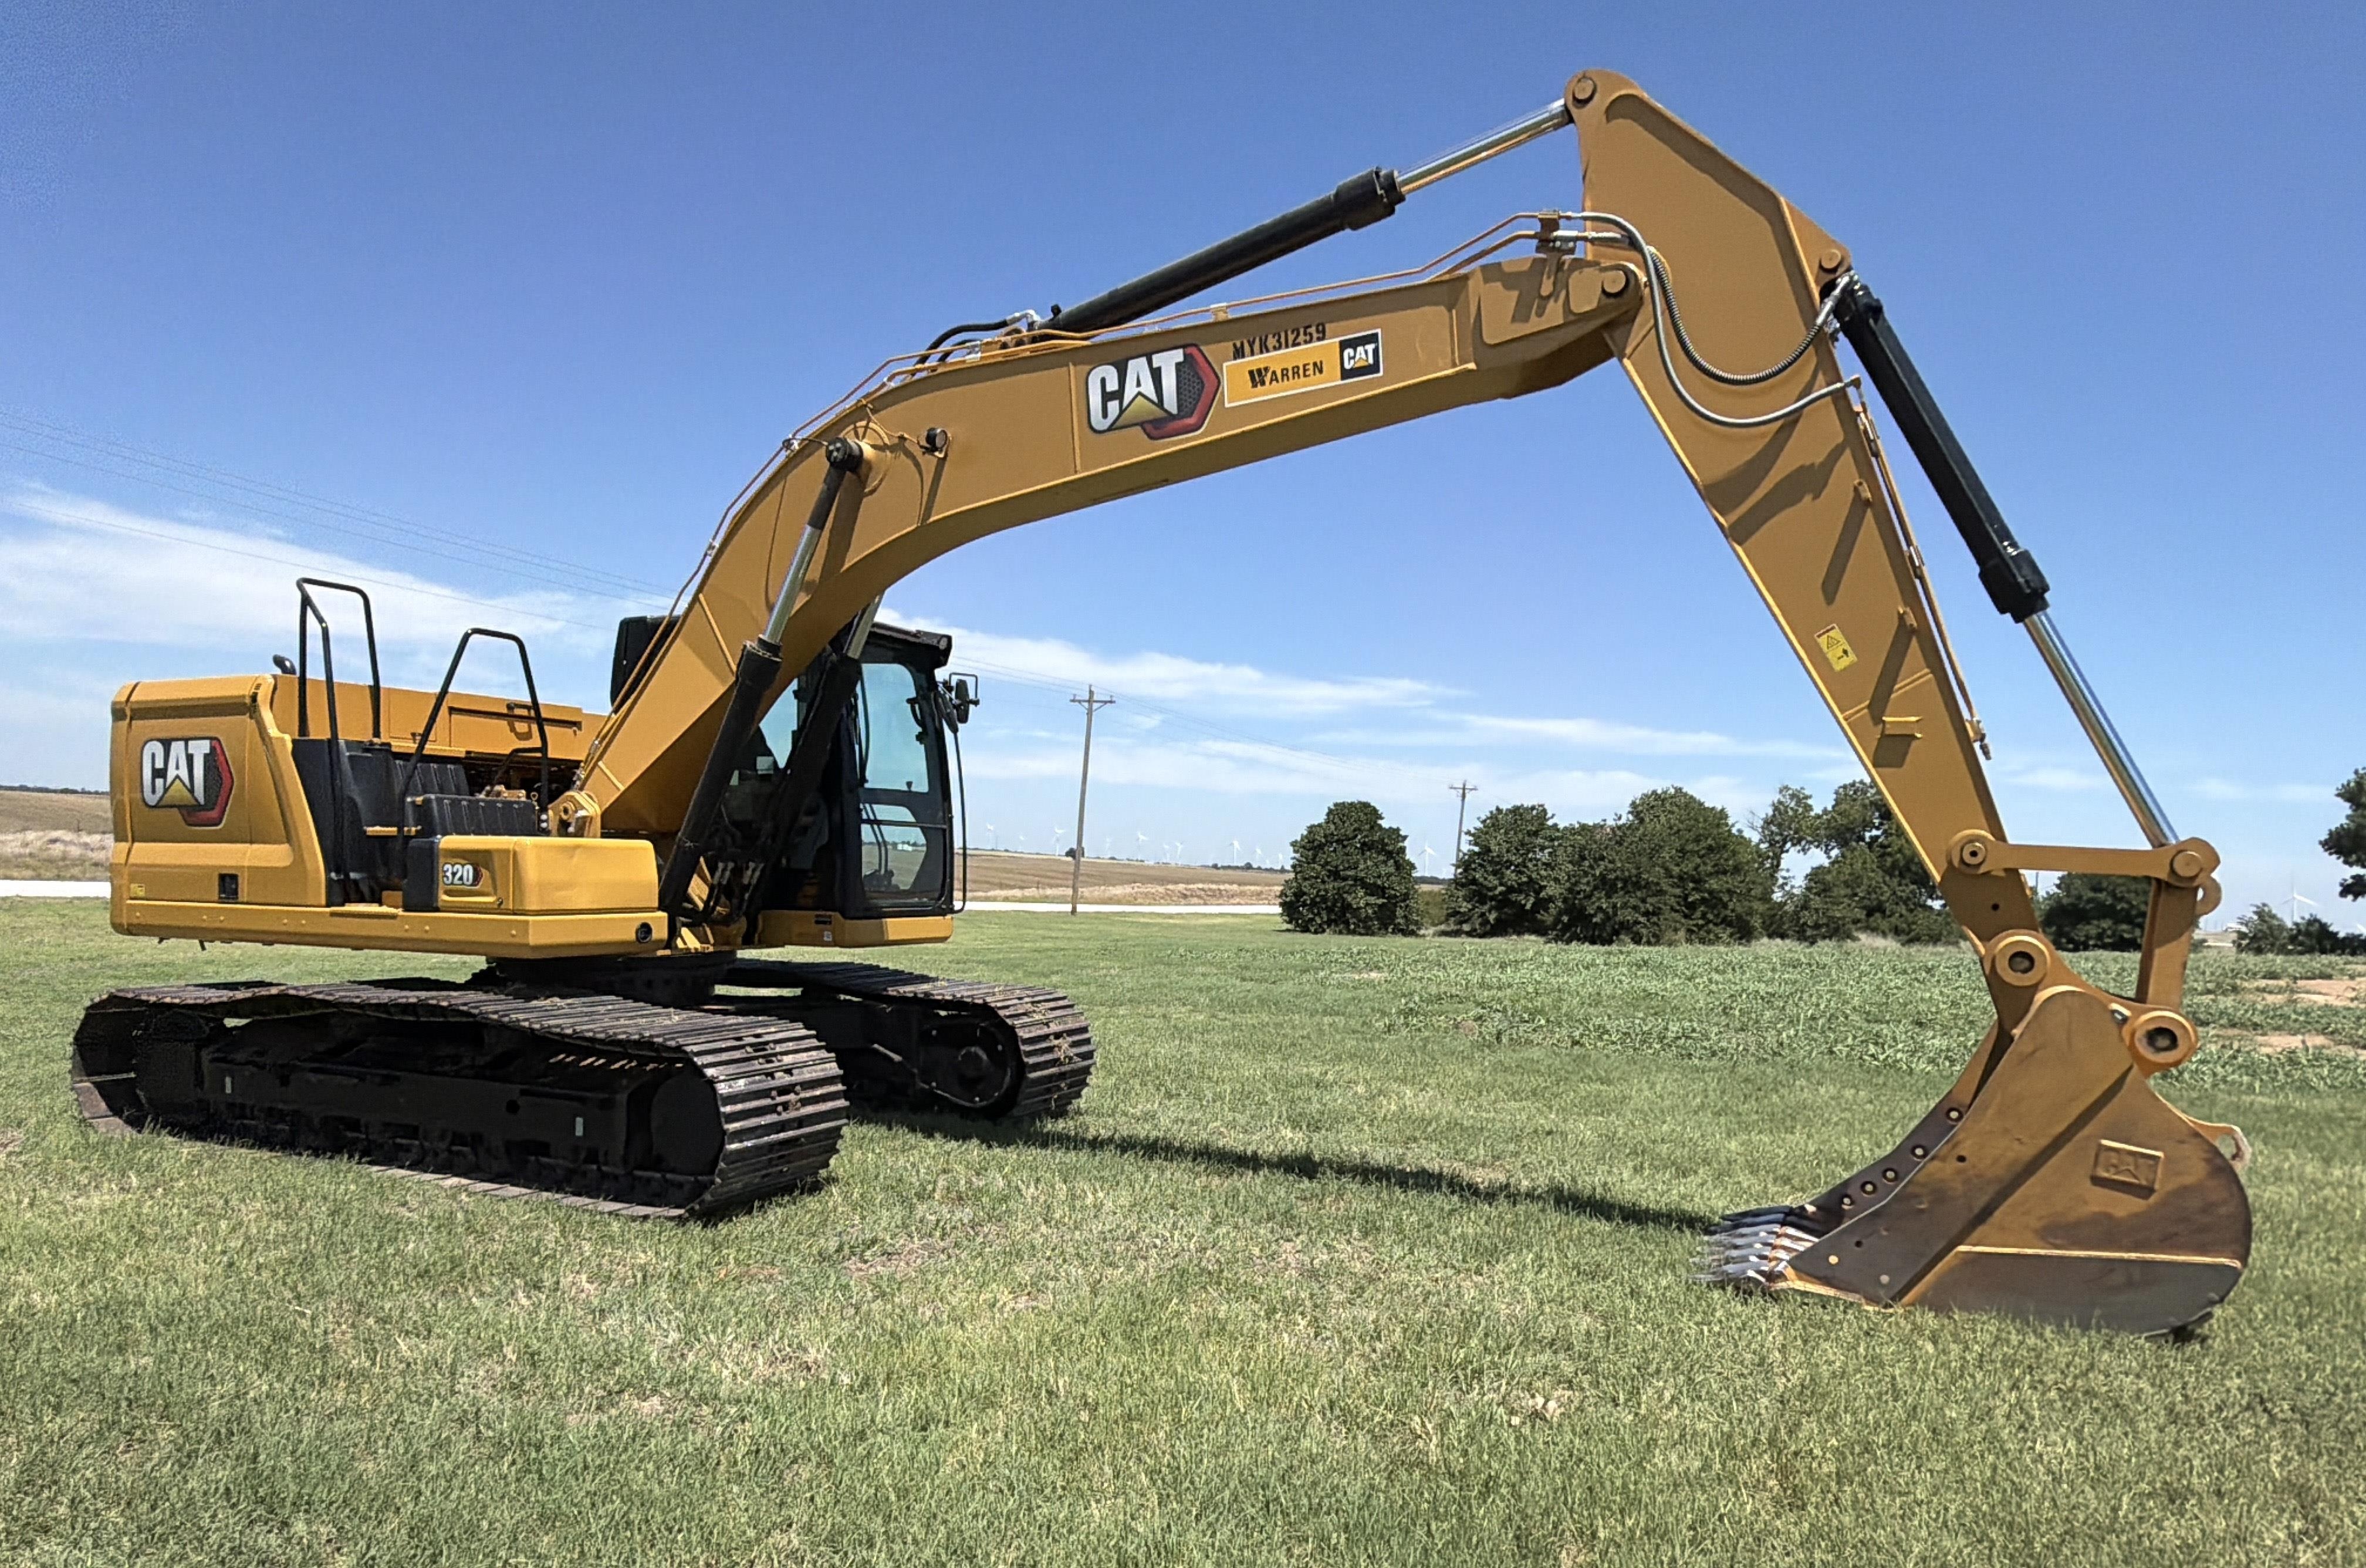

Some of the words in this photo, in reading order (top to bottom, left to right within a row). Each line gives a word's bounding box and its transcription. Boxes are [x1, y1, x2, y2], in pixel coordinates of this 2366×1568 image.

[1233, 322, 1327, 360] MYK31259
[1343, 343, 1376, 370] CAT
[1087, 348, 1185, 431] CAT
[1248, 360, 1324, 388] WARREN
[142, 739, 211, 807] CAT
[443, 863, 473, 885] 320
